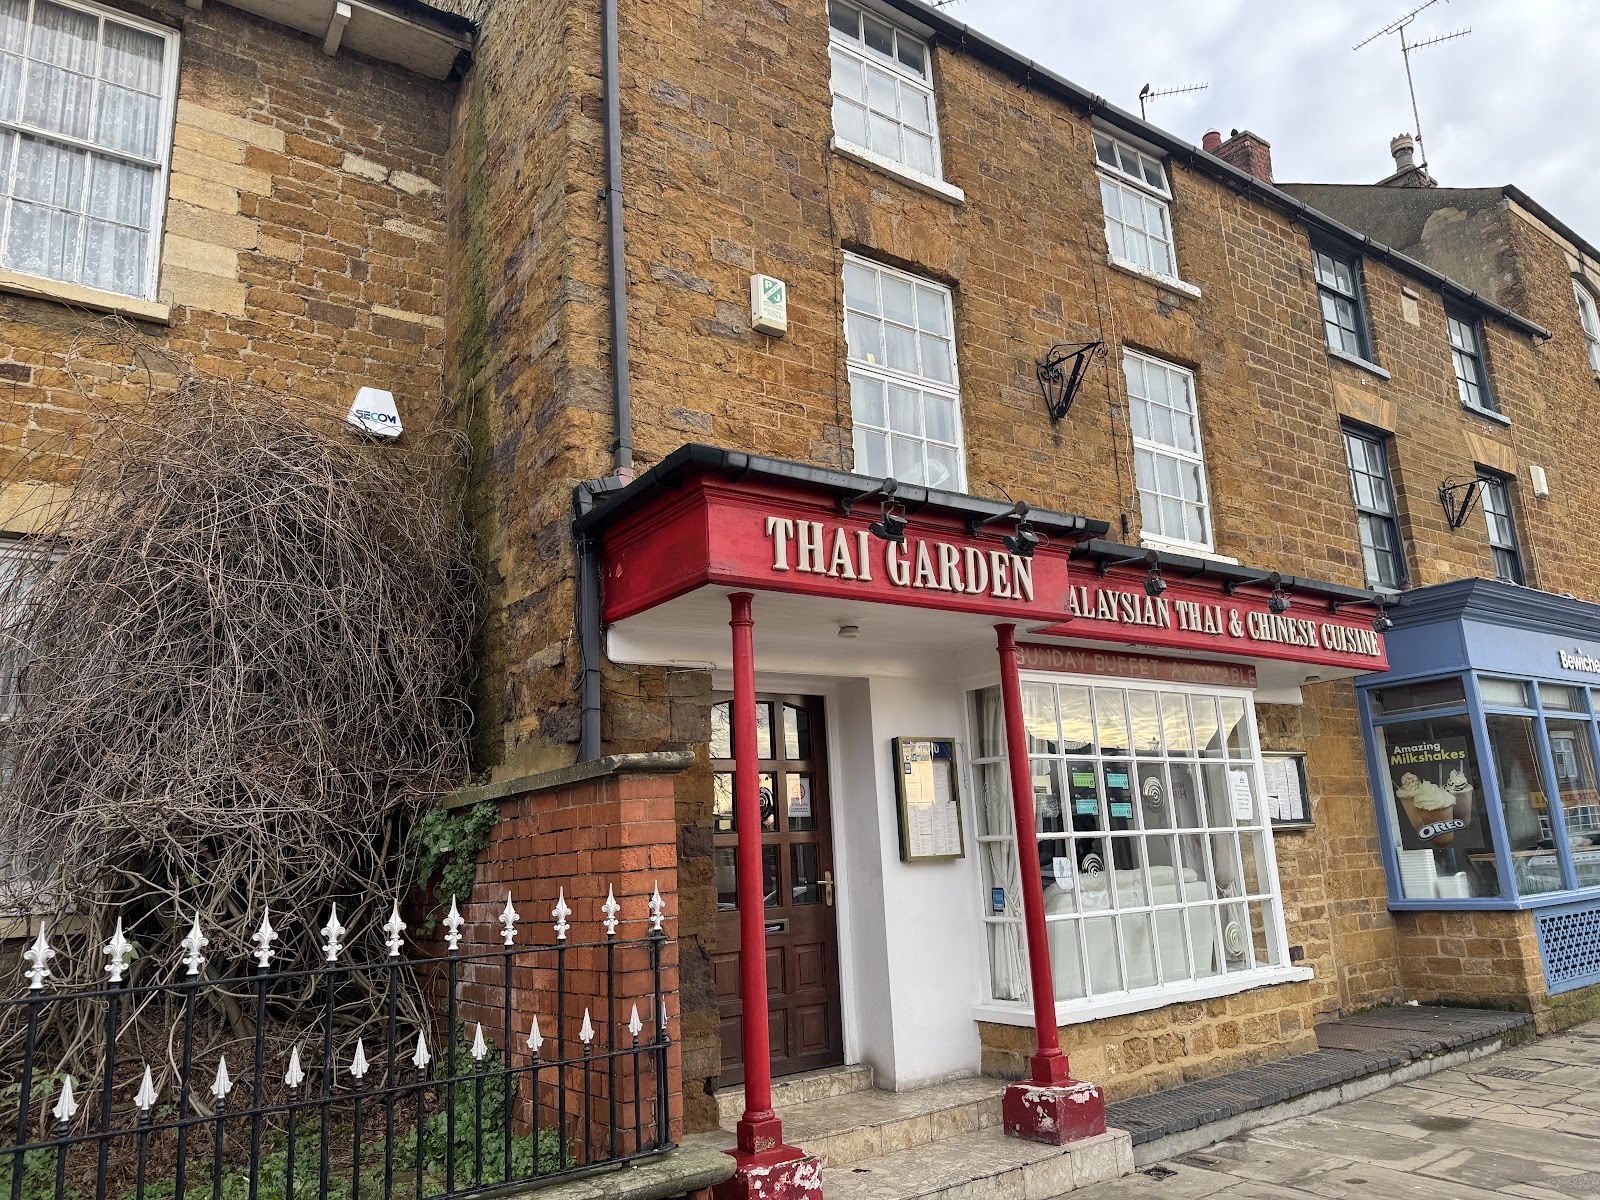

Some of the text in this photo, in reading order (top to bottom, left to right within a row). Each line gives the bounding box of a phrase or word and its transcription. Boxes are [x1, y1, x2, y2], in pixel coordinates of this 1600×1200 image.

[355, 409, 397, 424] SECOM
[766, 516, 1034, 602] THAI GARDEN
[1069, 584, 1382, 657] ALAYSIAN THAI & CHINESE CUISINE
[1015, 646, 1086, 670] SUNDAY
[1094, 653, 1159, 676] BUFFET
[1558, 649, 1600, 674] Bewiche
[1391, 749, 1466, 766] Milkshakes
[1393, 742, 1441, 755] Amazing
[1418, 819, 1465, 840] OREO
